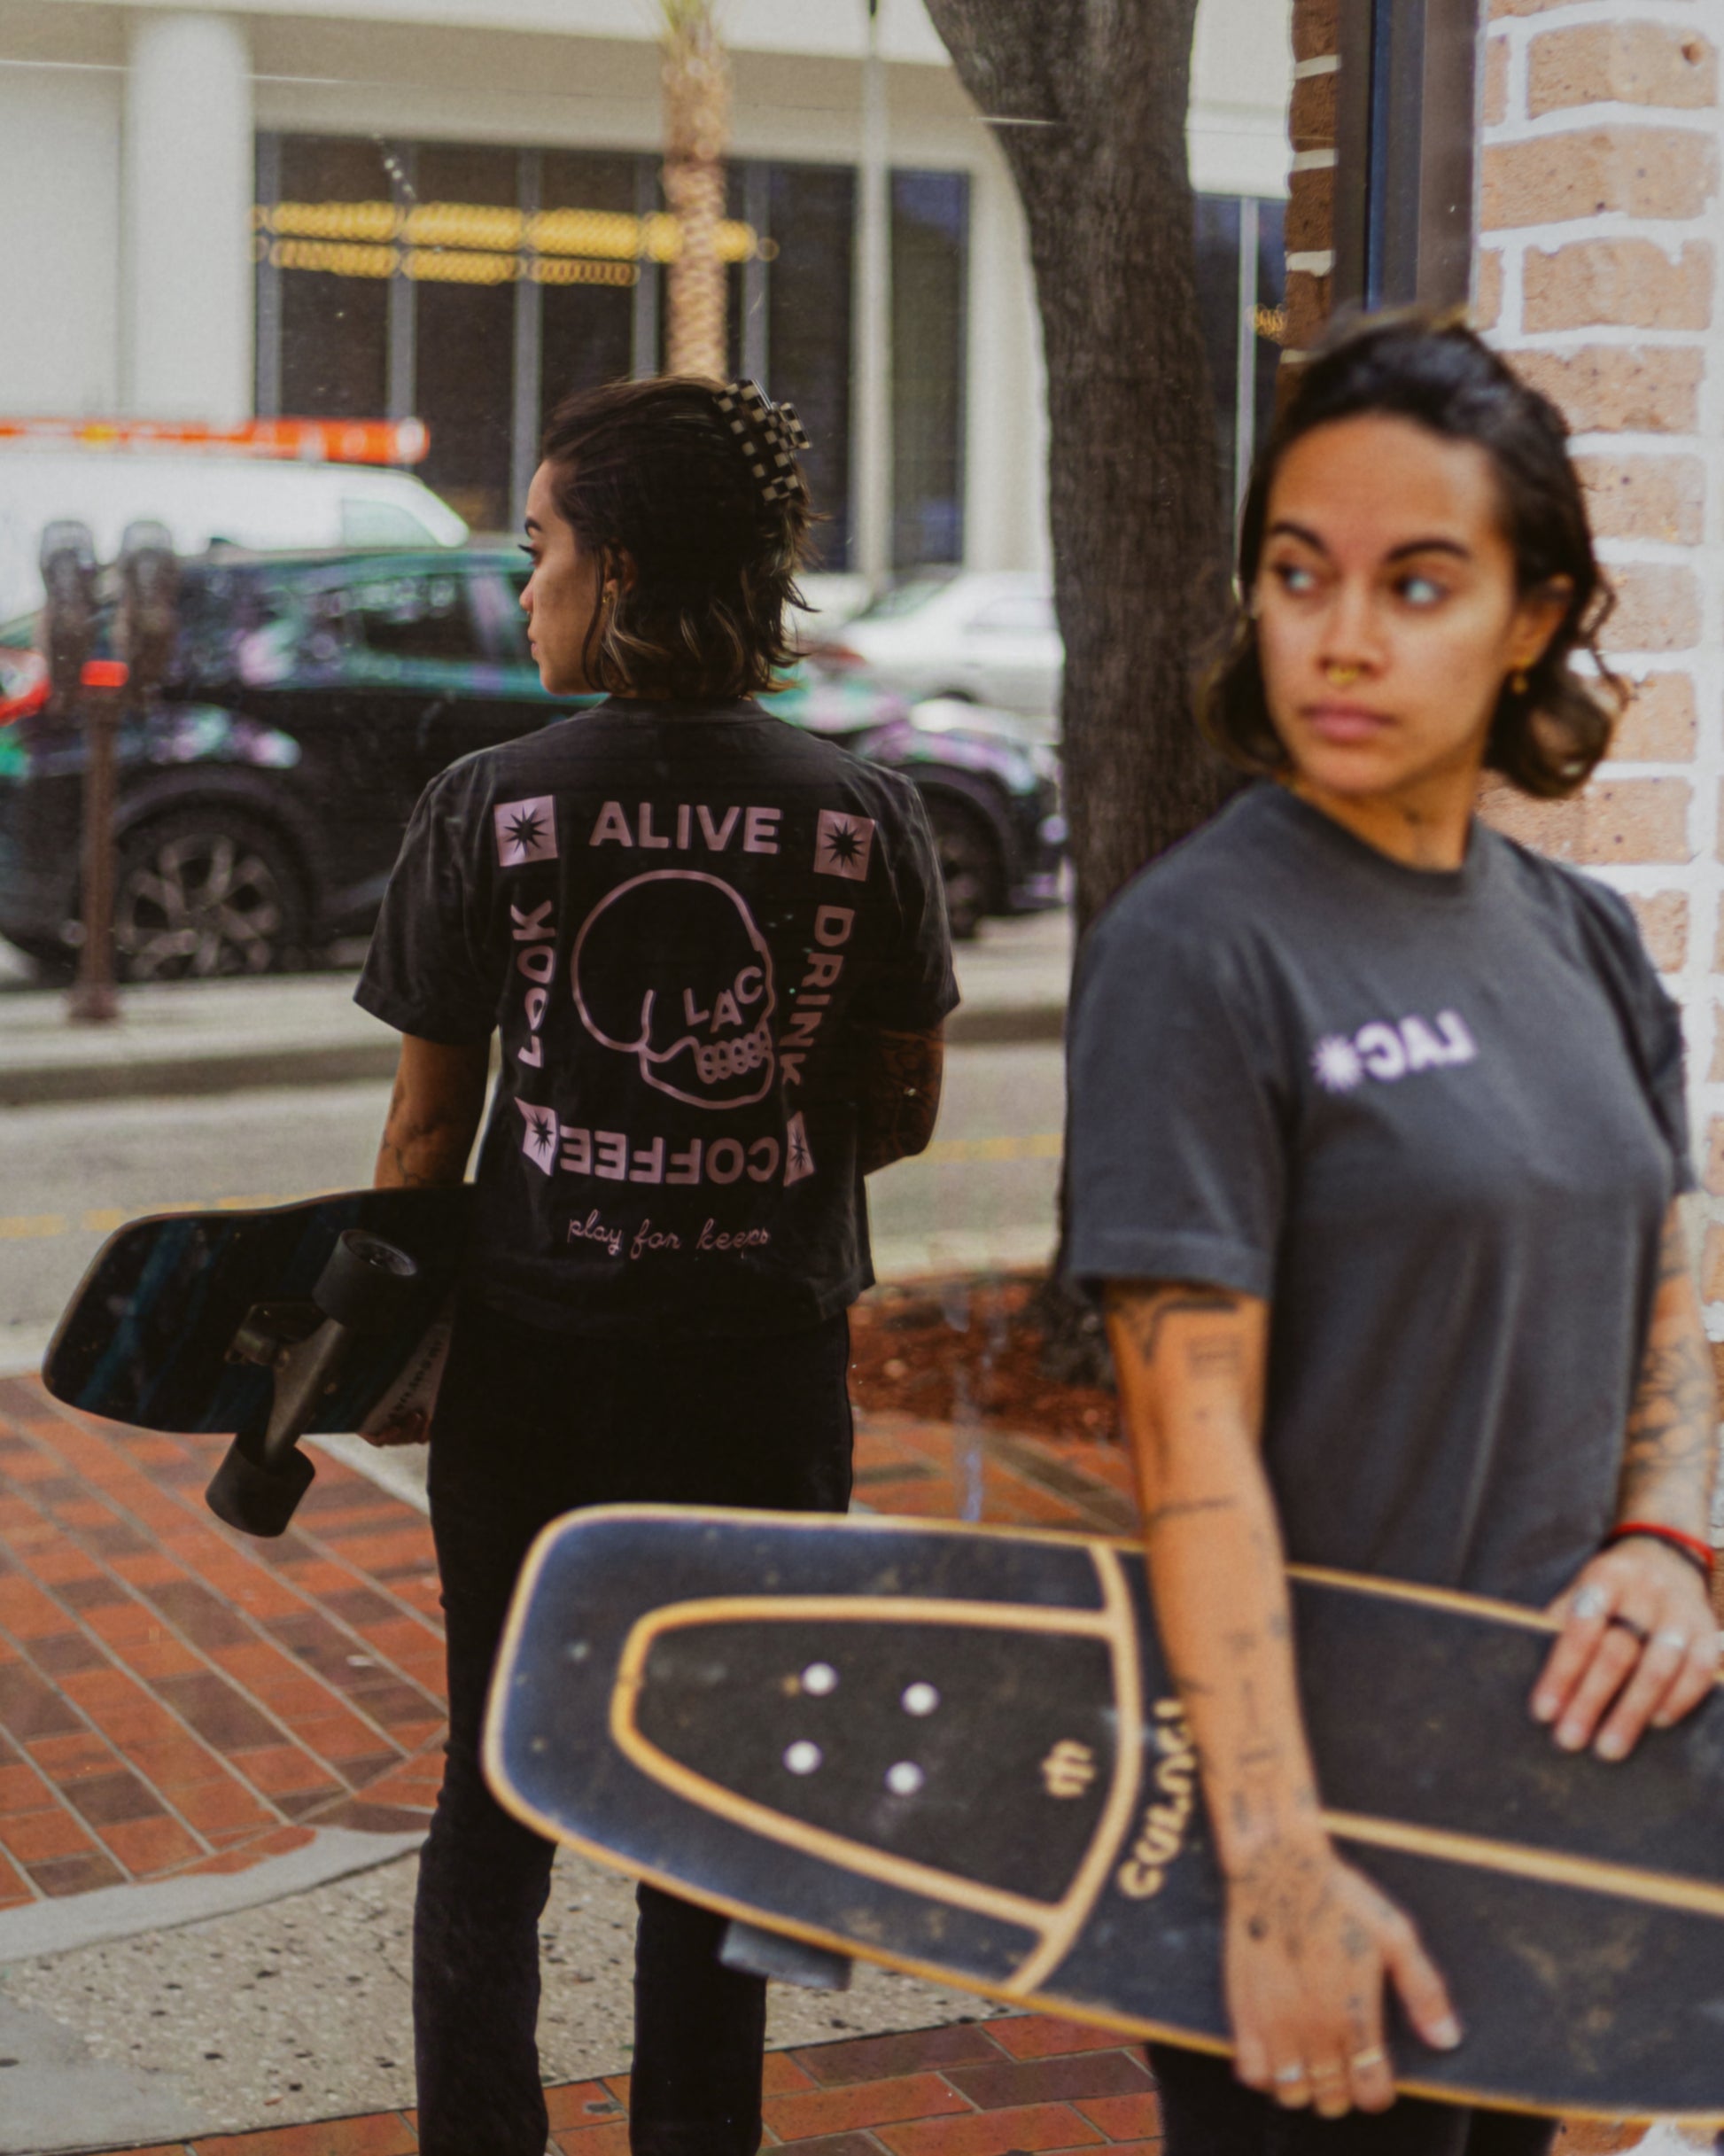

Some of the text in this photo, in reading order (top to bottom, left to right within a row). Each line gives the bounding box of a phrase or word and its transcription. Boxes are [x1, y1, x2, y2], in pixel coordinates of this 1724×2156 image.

[589, 801, 783, 854] ALIVE
[510, 900, 555, 1069] LOOK
[683, 966, 764, 1032] LAC
[779, 905, 855, 1086] DRINK
[560, 1125, 780, 1184] COFFEE
[567, 1209, 622, 1256] play
[630, 1218, 681, 1260] for
